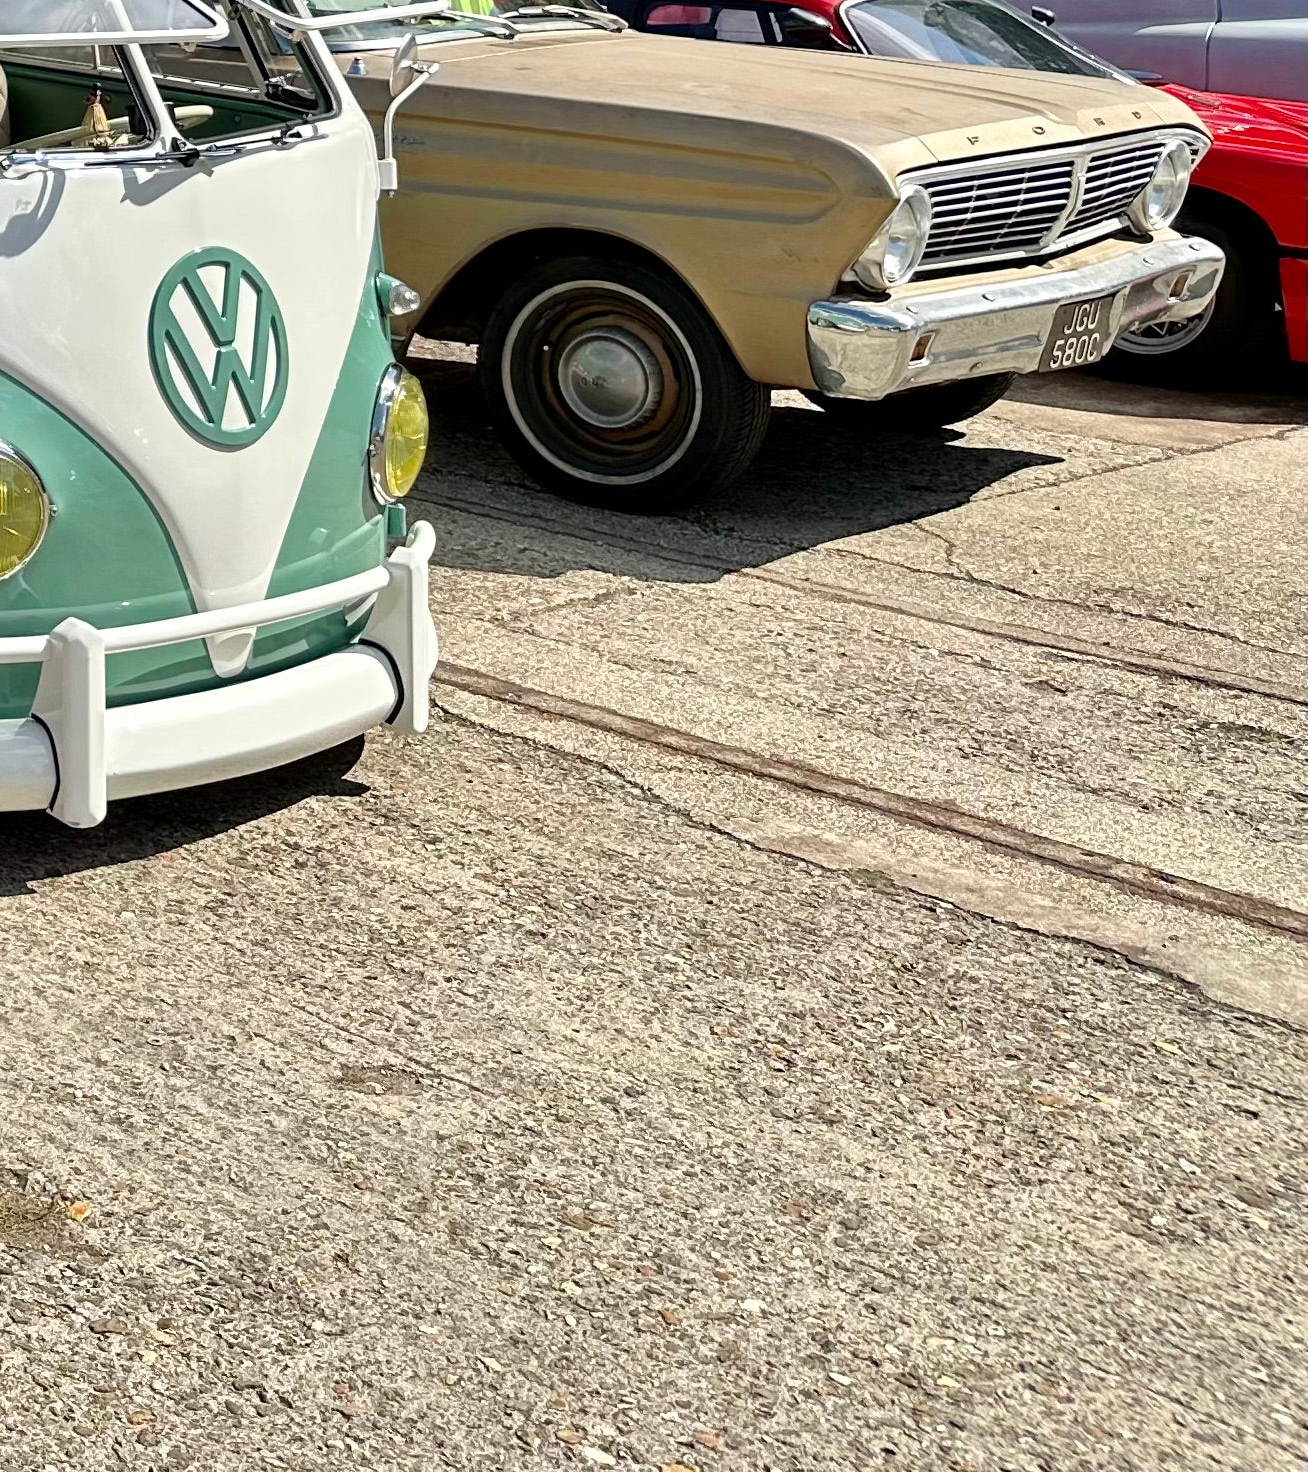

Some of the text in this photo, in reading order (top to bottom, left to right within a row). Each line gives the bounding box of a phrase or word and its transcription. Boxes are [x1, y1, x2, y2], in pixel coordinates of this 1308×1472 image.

[966, 111, 1142, 146] FORD
[1064, 301, 1101, 334] JGU
[151, 251, 285, 445] VW
[1050, 333, 1100, 368] 580C
